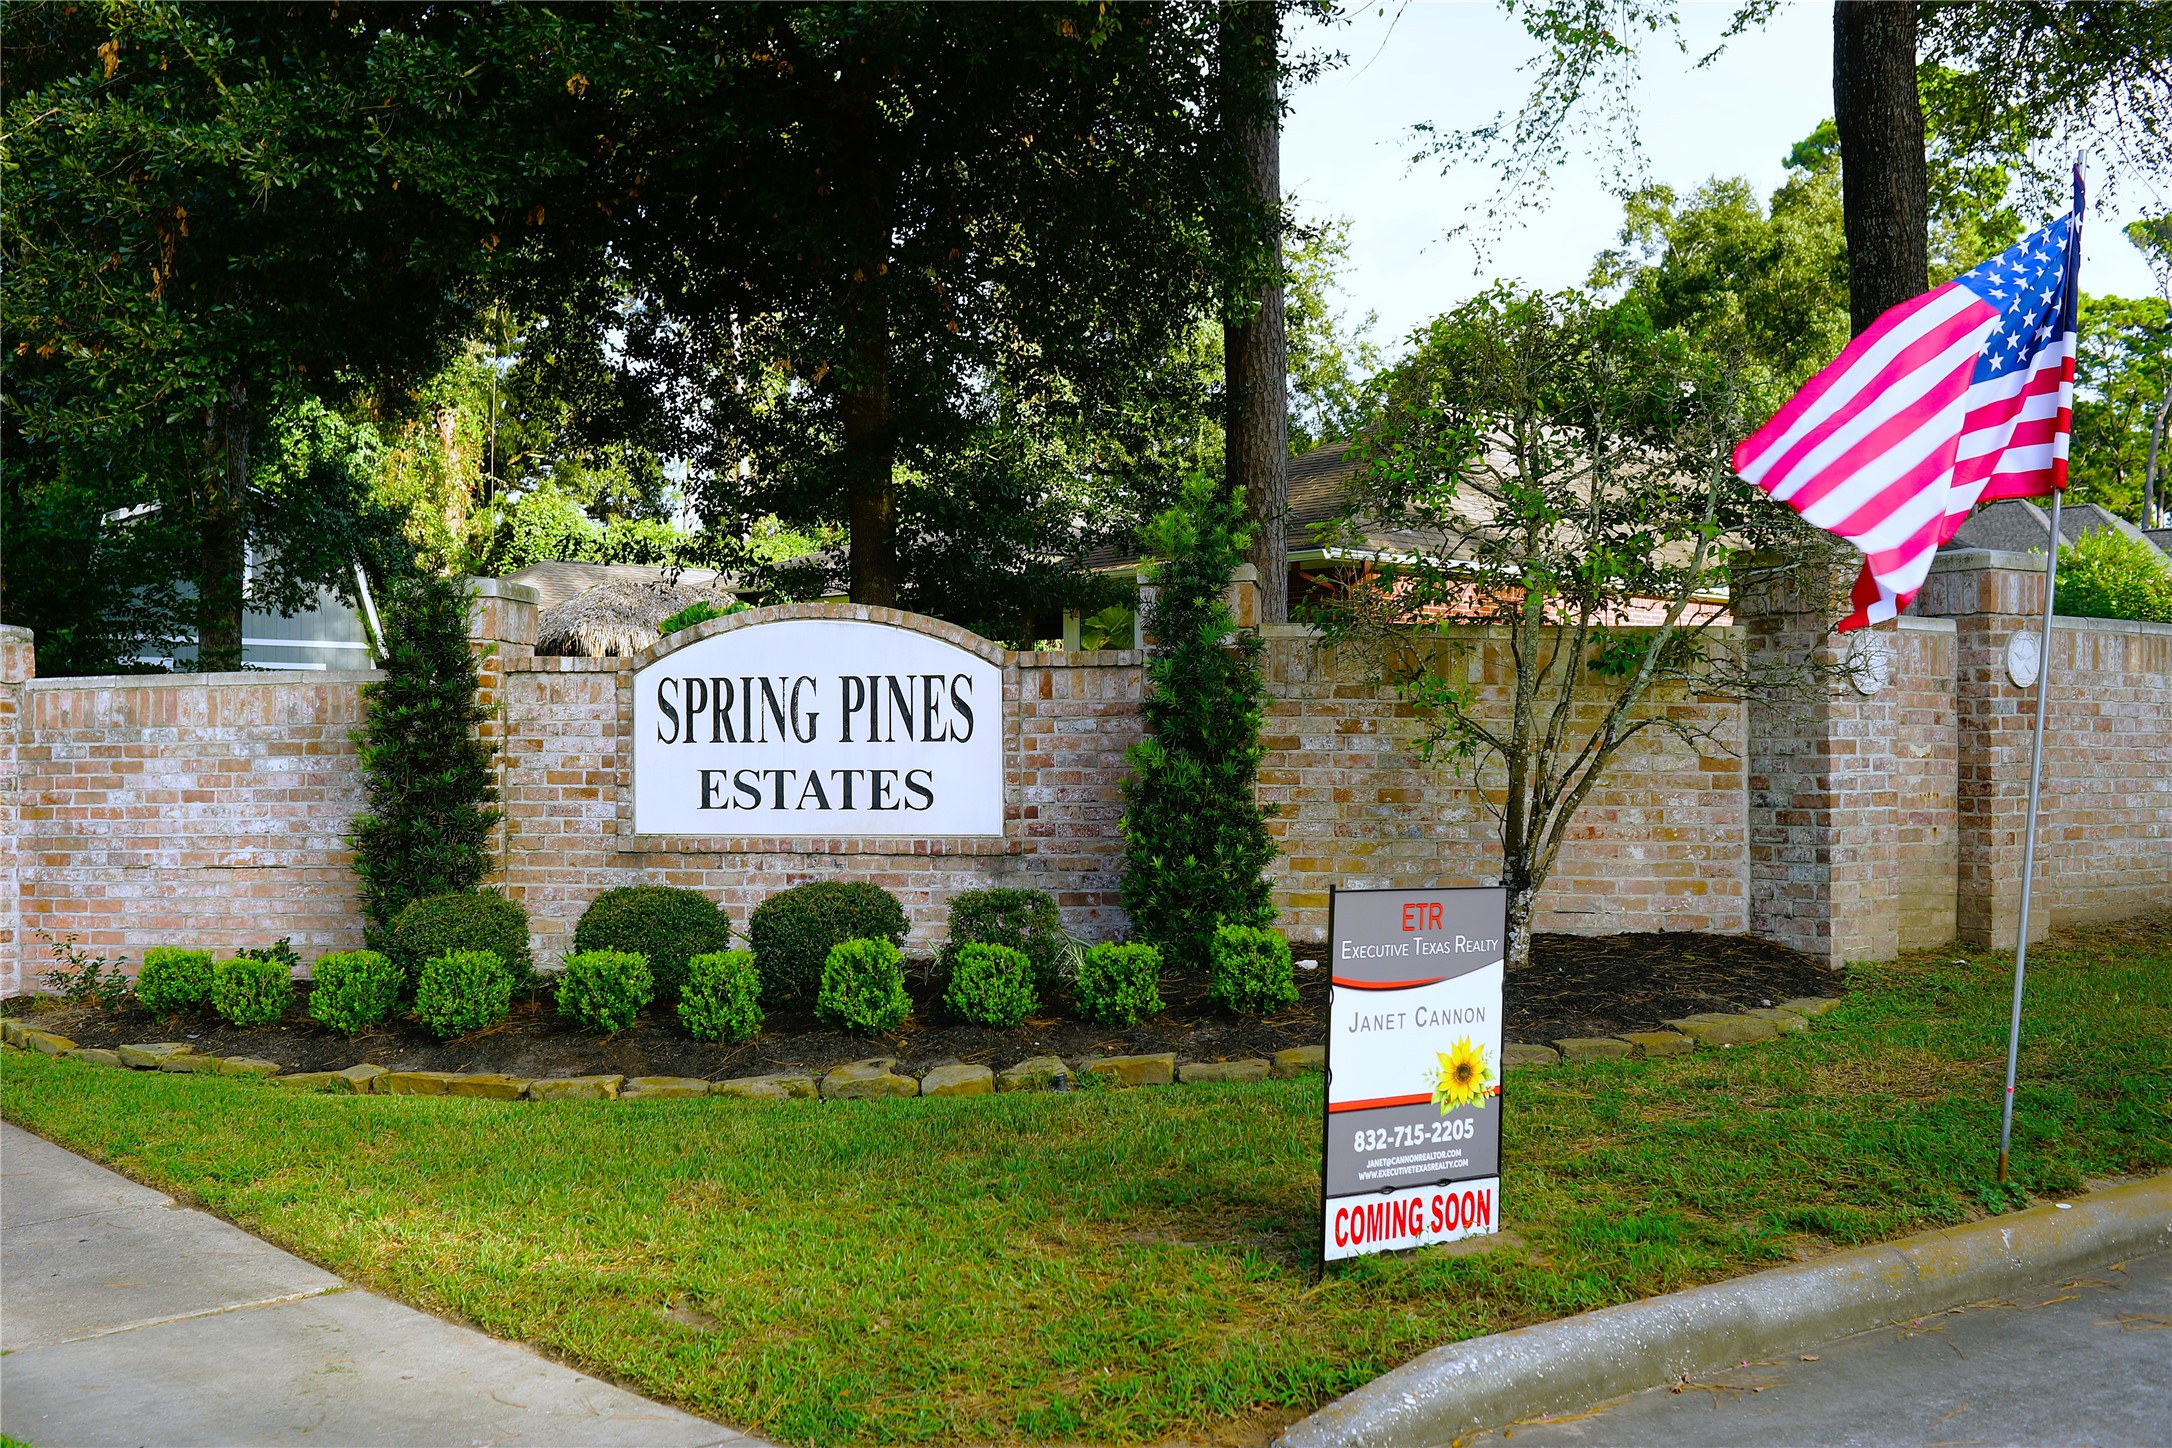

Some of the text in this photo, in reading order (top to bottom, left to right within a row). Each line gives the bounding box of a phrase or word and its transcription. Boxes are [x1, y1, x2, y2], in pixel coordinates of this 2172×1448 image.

[657, 673, 974, 745] SPRING PINES
[697, 769, 935, 811] ESTATES
[1402, 902, 1444, 932] ETR
[1341, 935, 1499, 960] EXECUTIVE TEXAS REALTY
[1348, 1006, 1486, 1033] JANET CANNON
[1354, 1118, 1474, 1152] 832-715-2205
[1358, 1159, 1469, 1181] WWW.EXECUTIVETEXASREALTY.COM
[1366, 1149, 1462, 1168] JANET@CANNONREALTOR.COM
[1335, 1189, 1491, 1248] COMING SOON
